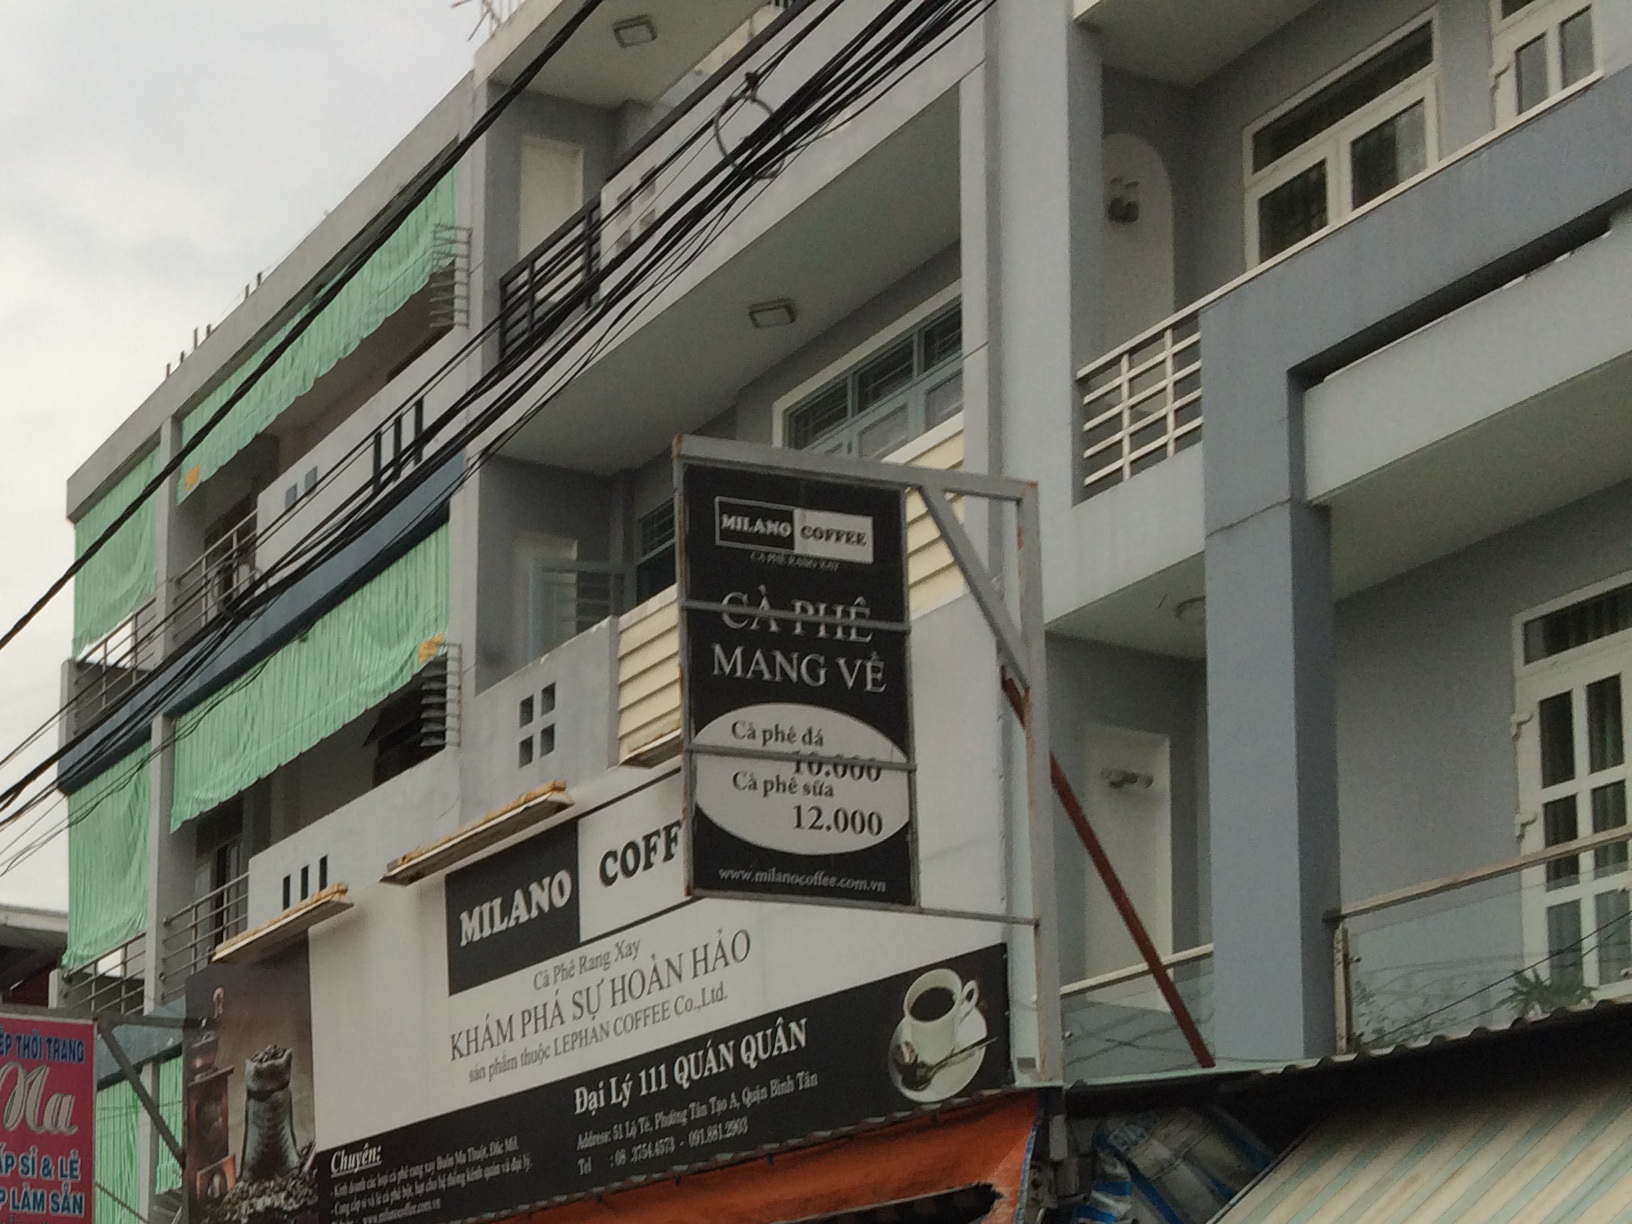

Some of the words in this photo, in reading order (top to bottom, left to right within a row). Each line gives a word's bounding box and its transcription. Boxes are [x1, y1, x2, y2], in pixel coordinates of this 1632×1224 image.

[721, 513, 792, 538] MILANO
[800, 526, 867, 547] COFFEE
[720, 585, 779, 633] CÀ
[792, 596, 874, 643] PHÊ
[711, 643, 827, 687] MANG
[836, 651, 887, 693] VỀ
[731, 720, 757, 740] Cà
[762, 724, 797, 747] phê
[801, 726, 824, 747] đá
[732, 771, 758, 791] Cà
[763, 774, 798, 798] phê
[793, 804, 883, 836] 12.000
[458, 869, 571, 948] MILANO
[598, 820, 683, 888] COFF
[718, 866, 886, 892] www.milanocoffee.com.vn
[533, 971, 550, 991] Cà
[553, 958, 575, 985] Phê
[578, 950, 610, 974] Rang
[615, 938, 641, 962] Xay
[450, 1012, 521, 1061] KHÁM
[520, 990, 565, 1038] PHÁ
[572, 978, 604, 1022] SỰ
[610, 953, 683, 1008] HOÀN
[691, 928, 751, 979] HẢO
[553, 1021, 610, 1057] LEPHAN
[613, 1001, 671, 1038] COFFEE
[45, 1038, 85, 1064] TRANG
[574, 1080, 605, 1117] Đại
[609, 1072, 633, 1108] Lý
[639, 1063, 669, 1096] 111
[674, 1039, 736, 1089] QUÁN
[740, 1016, 808, 1070] QUÂN
[41, 1155, 54, 1180] &
